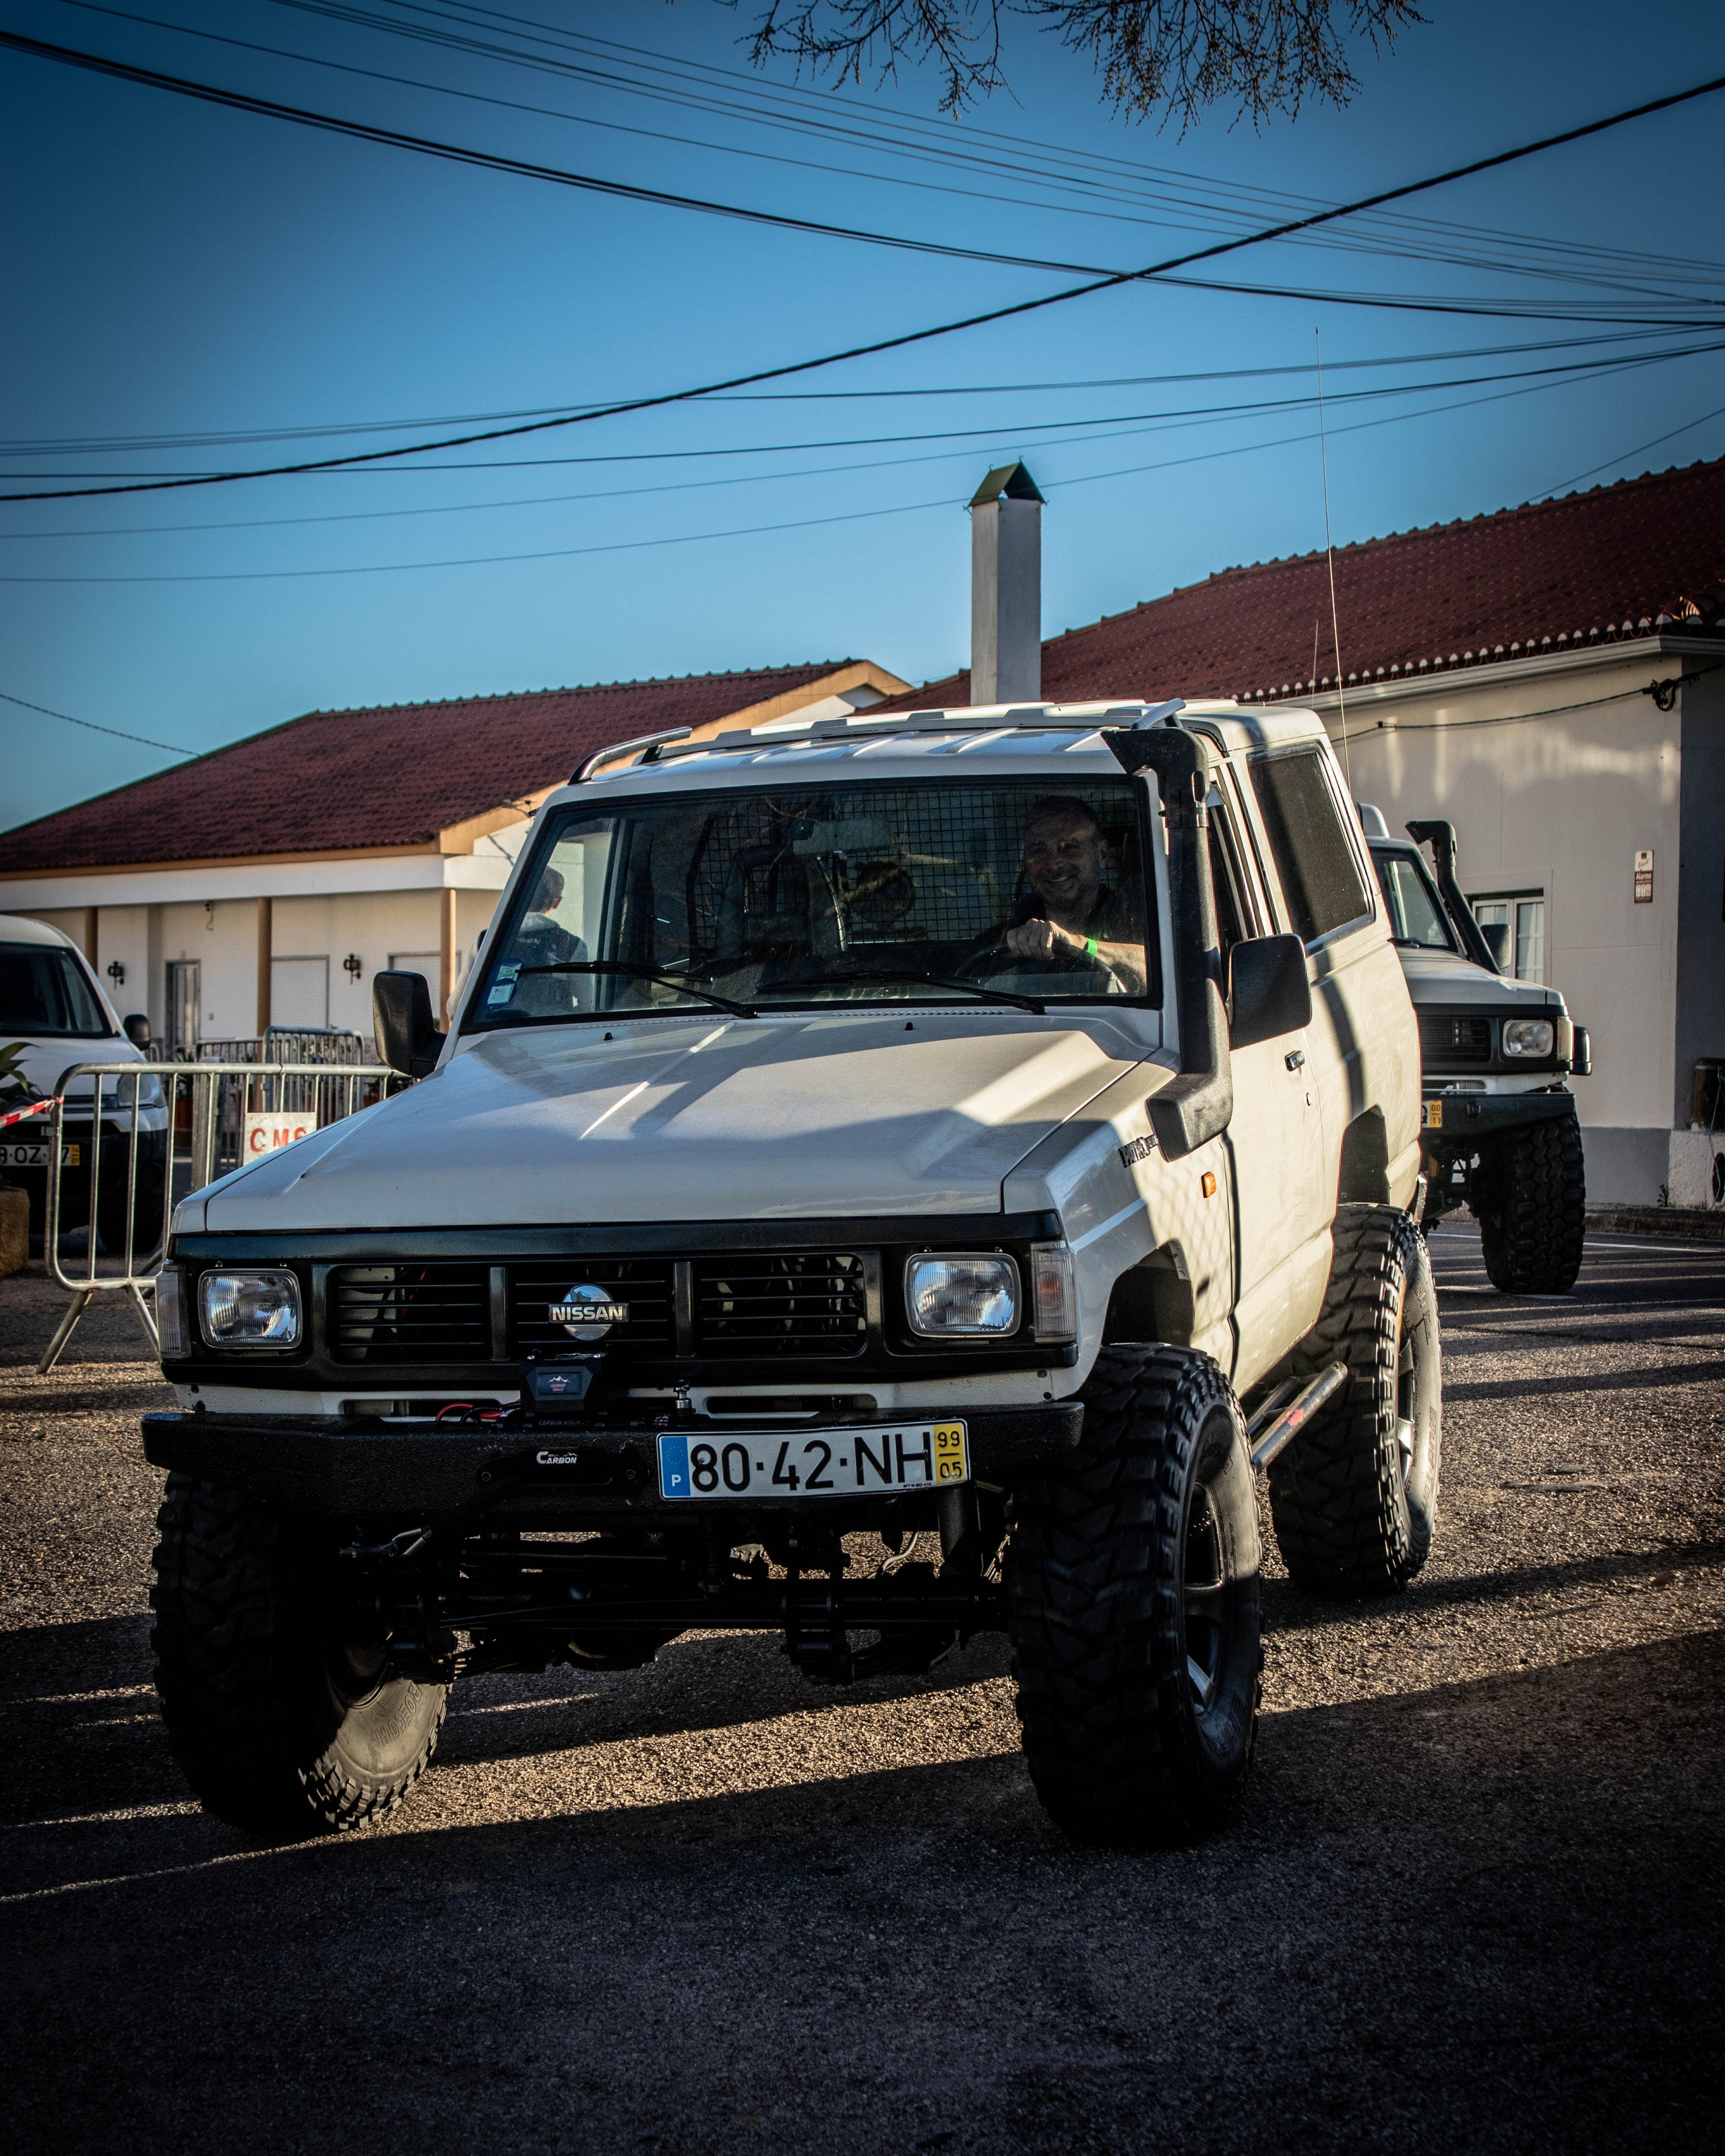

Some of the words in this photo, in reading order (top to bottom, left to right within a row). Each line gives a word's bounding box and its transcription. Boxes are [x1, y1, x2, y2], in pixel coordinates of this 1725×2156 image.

[1119, 1136, 1150, 1168] PATRO
[553, 1306, 623, 1321] NISSAN
[938, 1431, 960, 1447] 99
[536, 1451, 577, 1464] CARBON
[940, 1461, 962, 1478] 05
[672, 1474, 681, 1487] P
